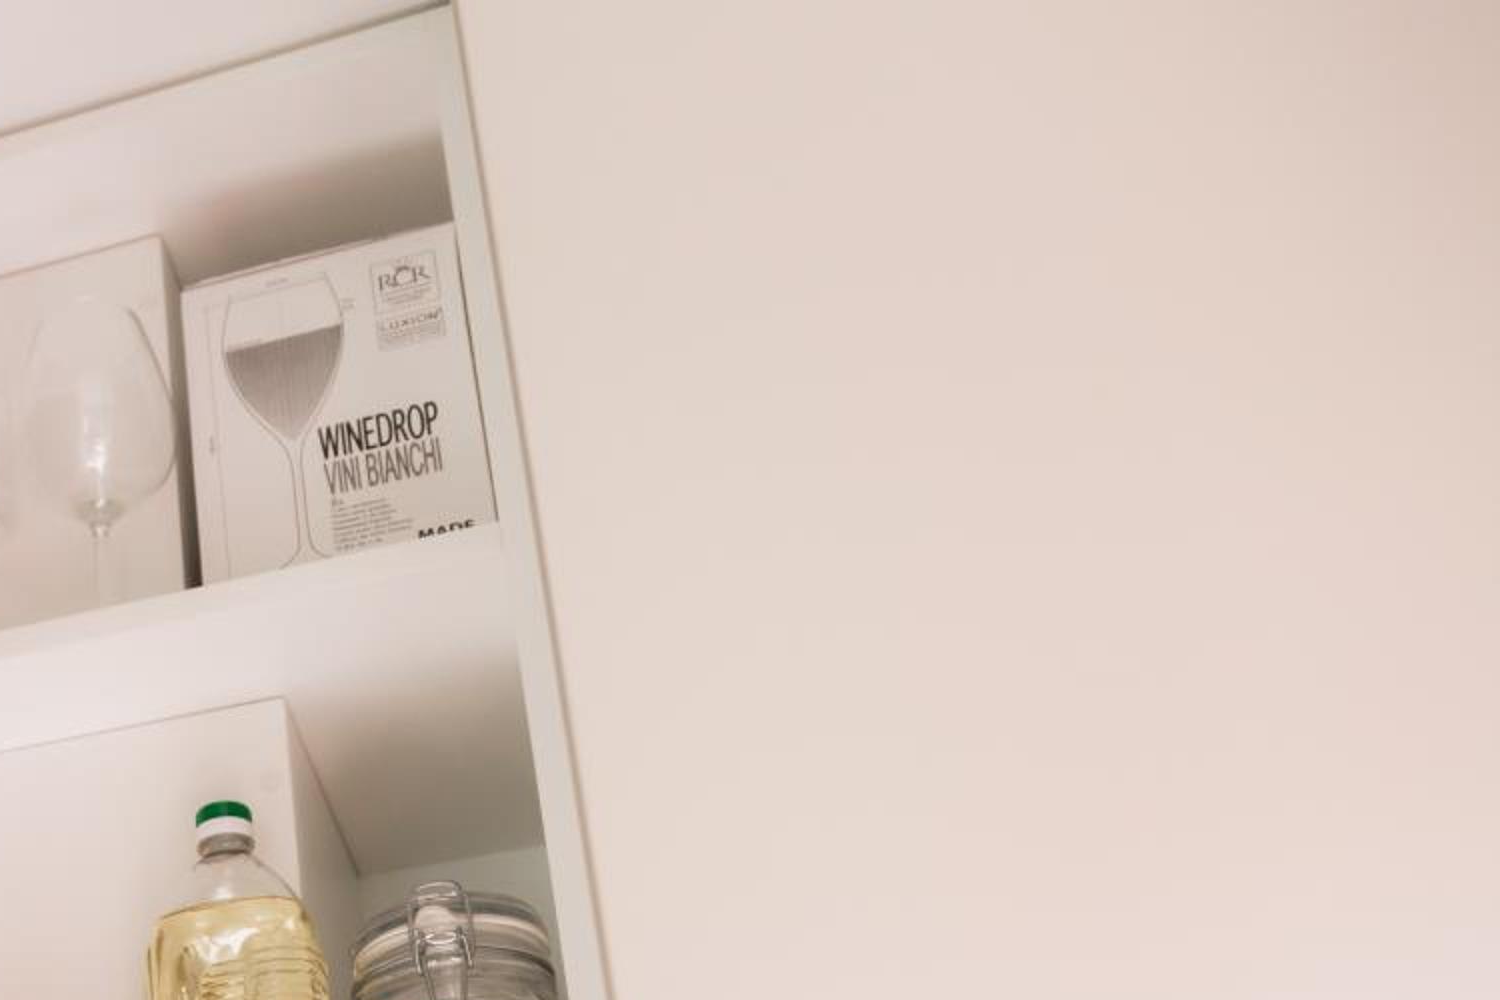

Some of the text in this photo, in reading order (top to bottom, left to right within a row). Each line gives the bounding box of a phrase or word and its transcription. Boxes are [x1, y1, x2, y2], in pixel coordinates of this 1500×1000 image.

[318, 401, 438, 460] WINEDROP
[324, 436, 443, 495] VINI BIANCHI
